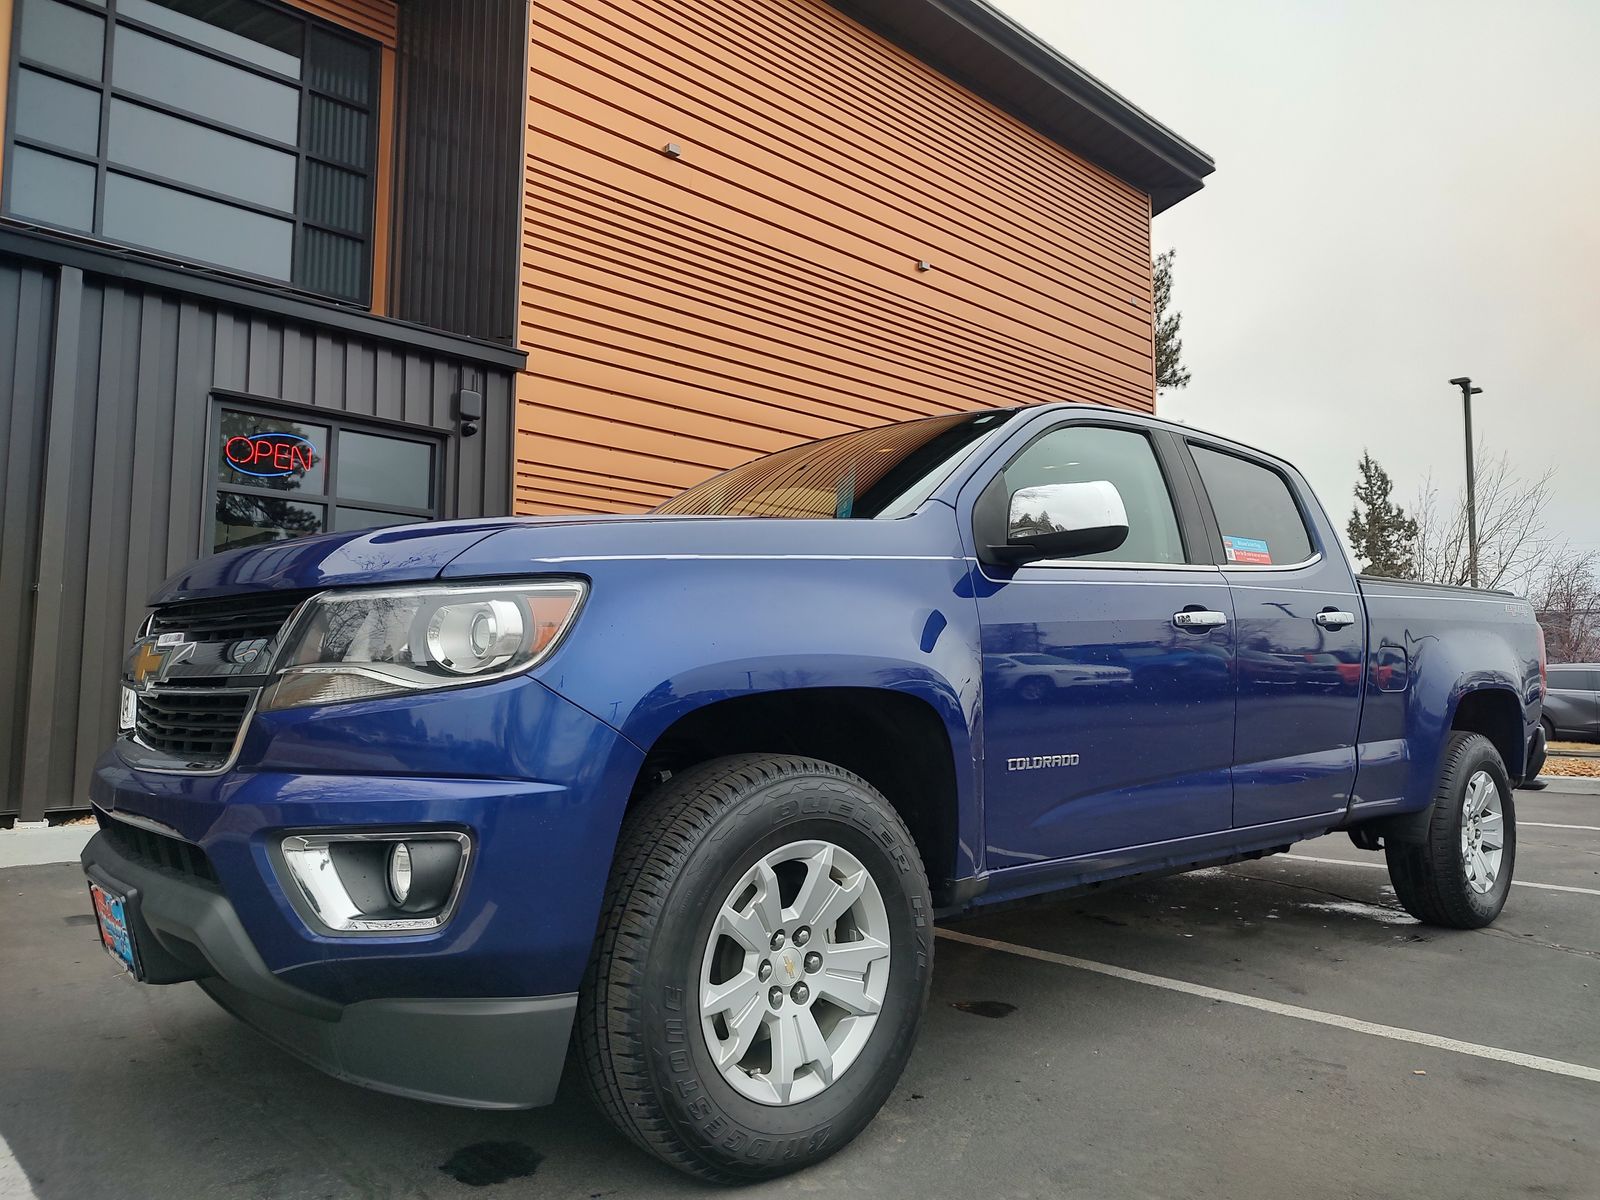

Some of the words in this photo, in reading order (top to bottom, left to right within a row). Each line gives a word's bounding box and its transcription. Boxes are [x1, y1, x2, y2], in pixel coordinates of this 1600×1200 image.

[225, 436, 313, 472] OPEN
[1007, 753, 1080, 771] COLORADO
[773, 796, 911, 875] DUELER
[664, 985, 833, 1161] BRIDGESTONE
